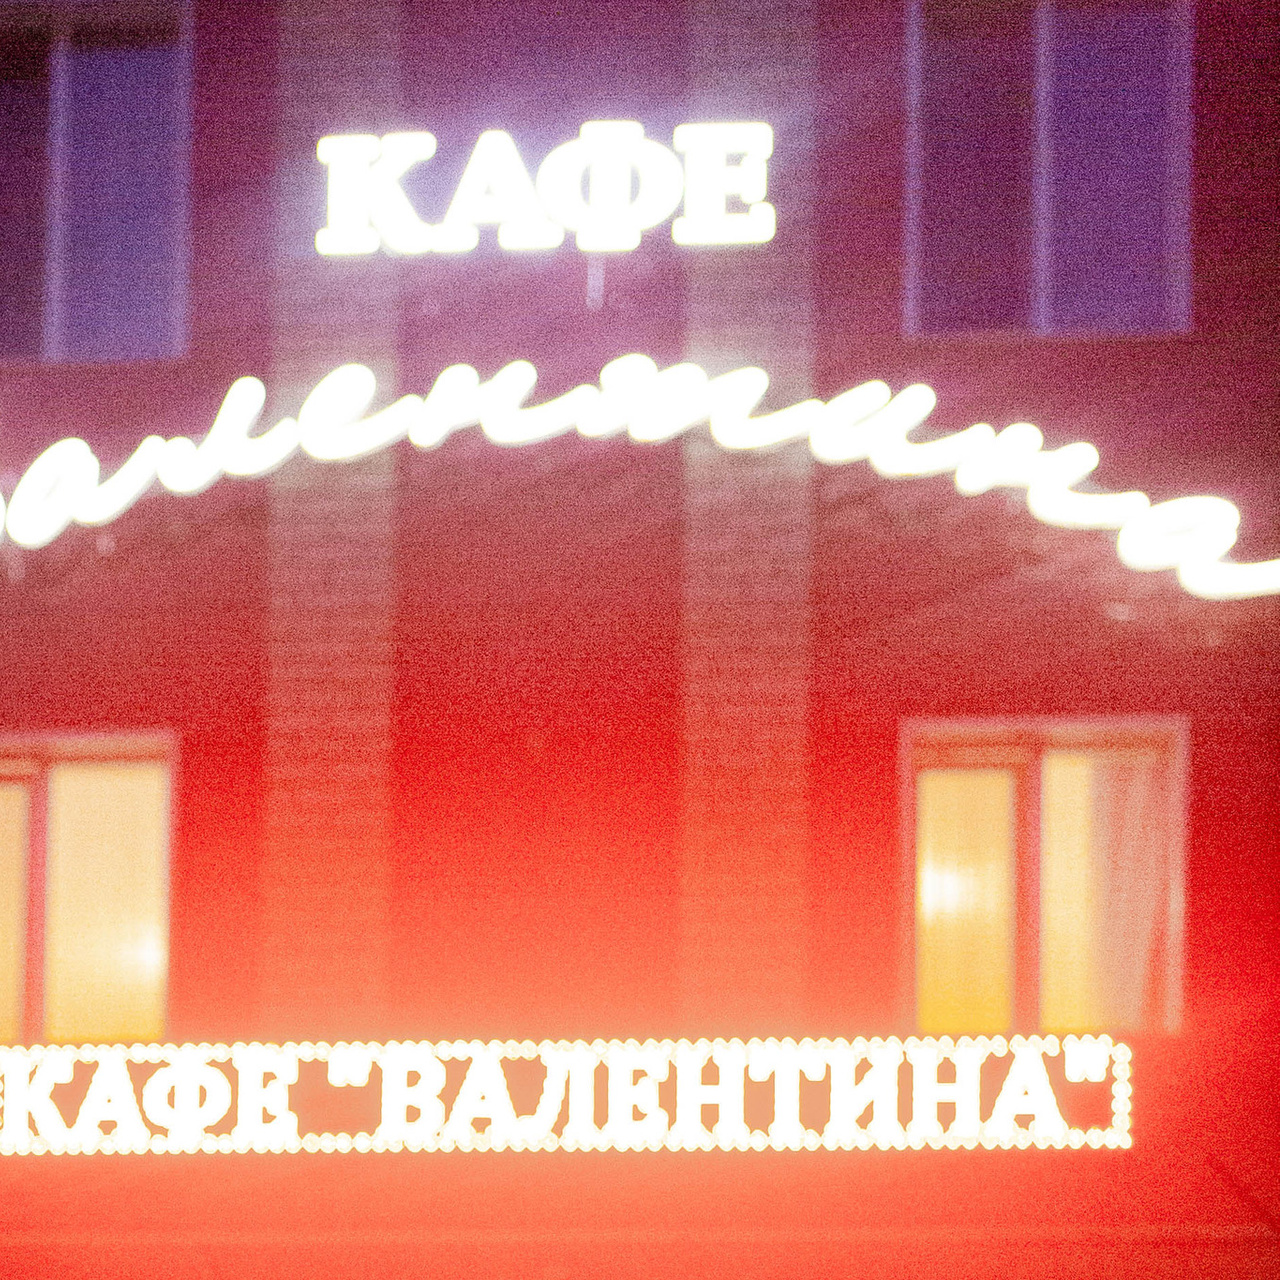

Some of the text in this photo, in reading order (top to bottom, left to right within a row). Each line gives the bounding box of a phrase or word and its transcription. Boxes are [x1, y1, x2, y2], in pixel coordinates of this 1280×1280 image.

[316, 119, 776, 257] КАФЕ
[1, 1038, 1110, 1148] КАФЕ "ВАЛЕНТИНА"
